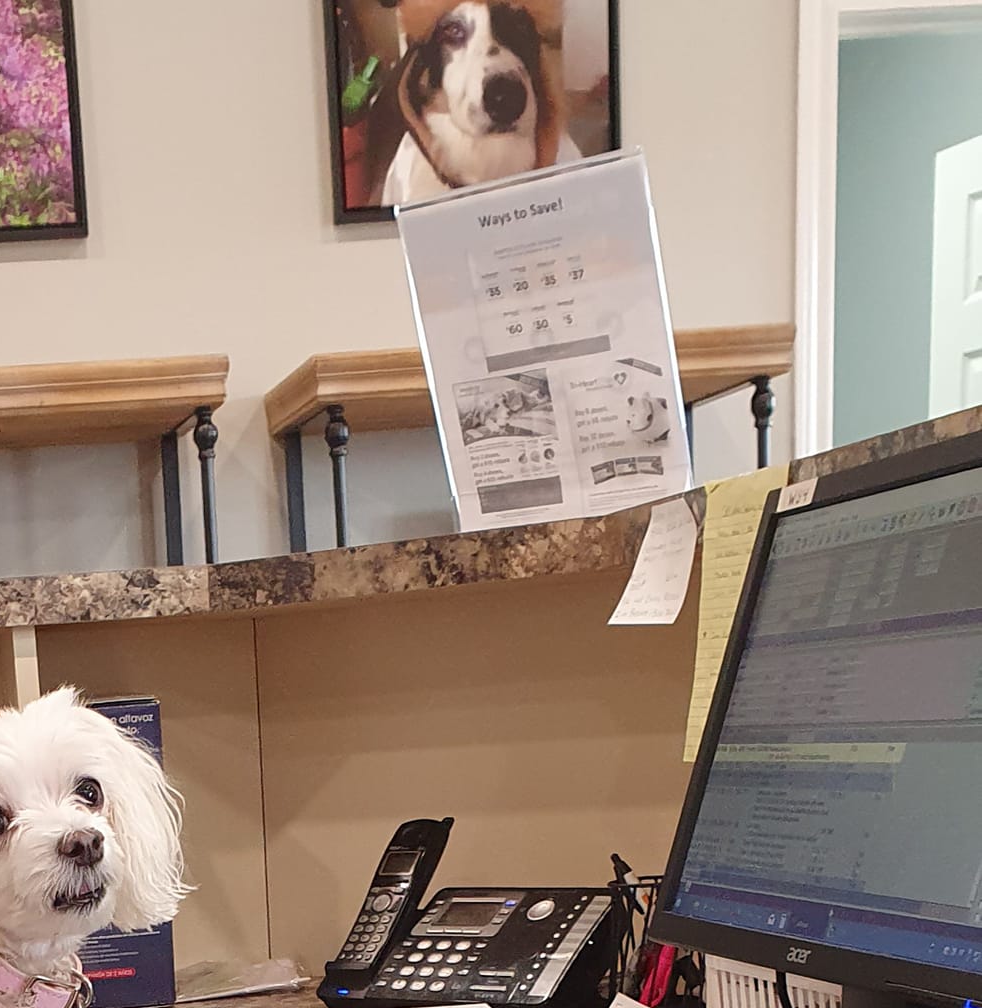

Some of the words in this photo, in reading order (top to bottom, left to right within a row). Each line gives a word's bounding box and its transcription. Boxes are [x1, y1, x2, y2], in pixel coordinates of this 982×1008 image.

[478, 212, 512, 228] Ways
[514, 208, 527, 220] to
[529, 197, 563, 216] Save!
[787, 947, 812, 964] acer
